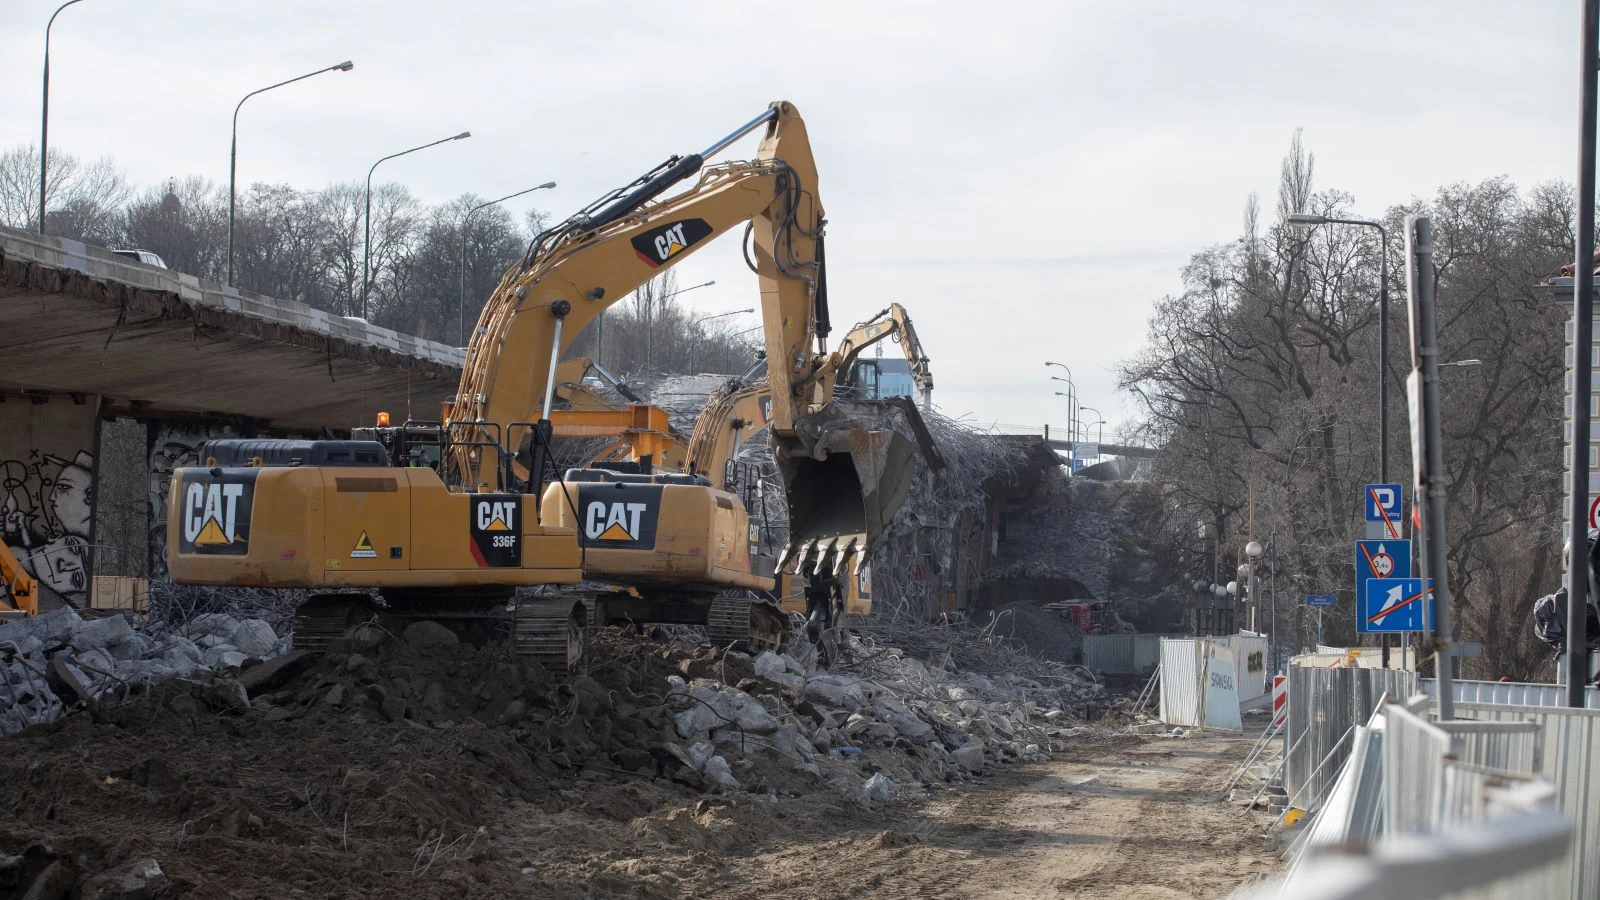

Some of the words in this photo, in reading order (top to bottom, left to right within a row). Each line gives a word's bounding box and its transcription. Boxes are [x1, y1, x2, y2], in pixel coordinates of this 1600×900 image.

[654, 222, 688, 260] CAT
[184, 482, 244, 544] CAT
[477, 501, 516, 531] CAT
[585, 501, 647, 541] CAT
[492, 535, 516, 548] 336F
